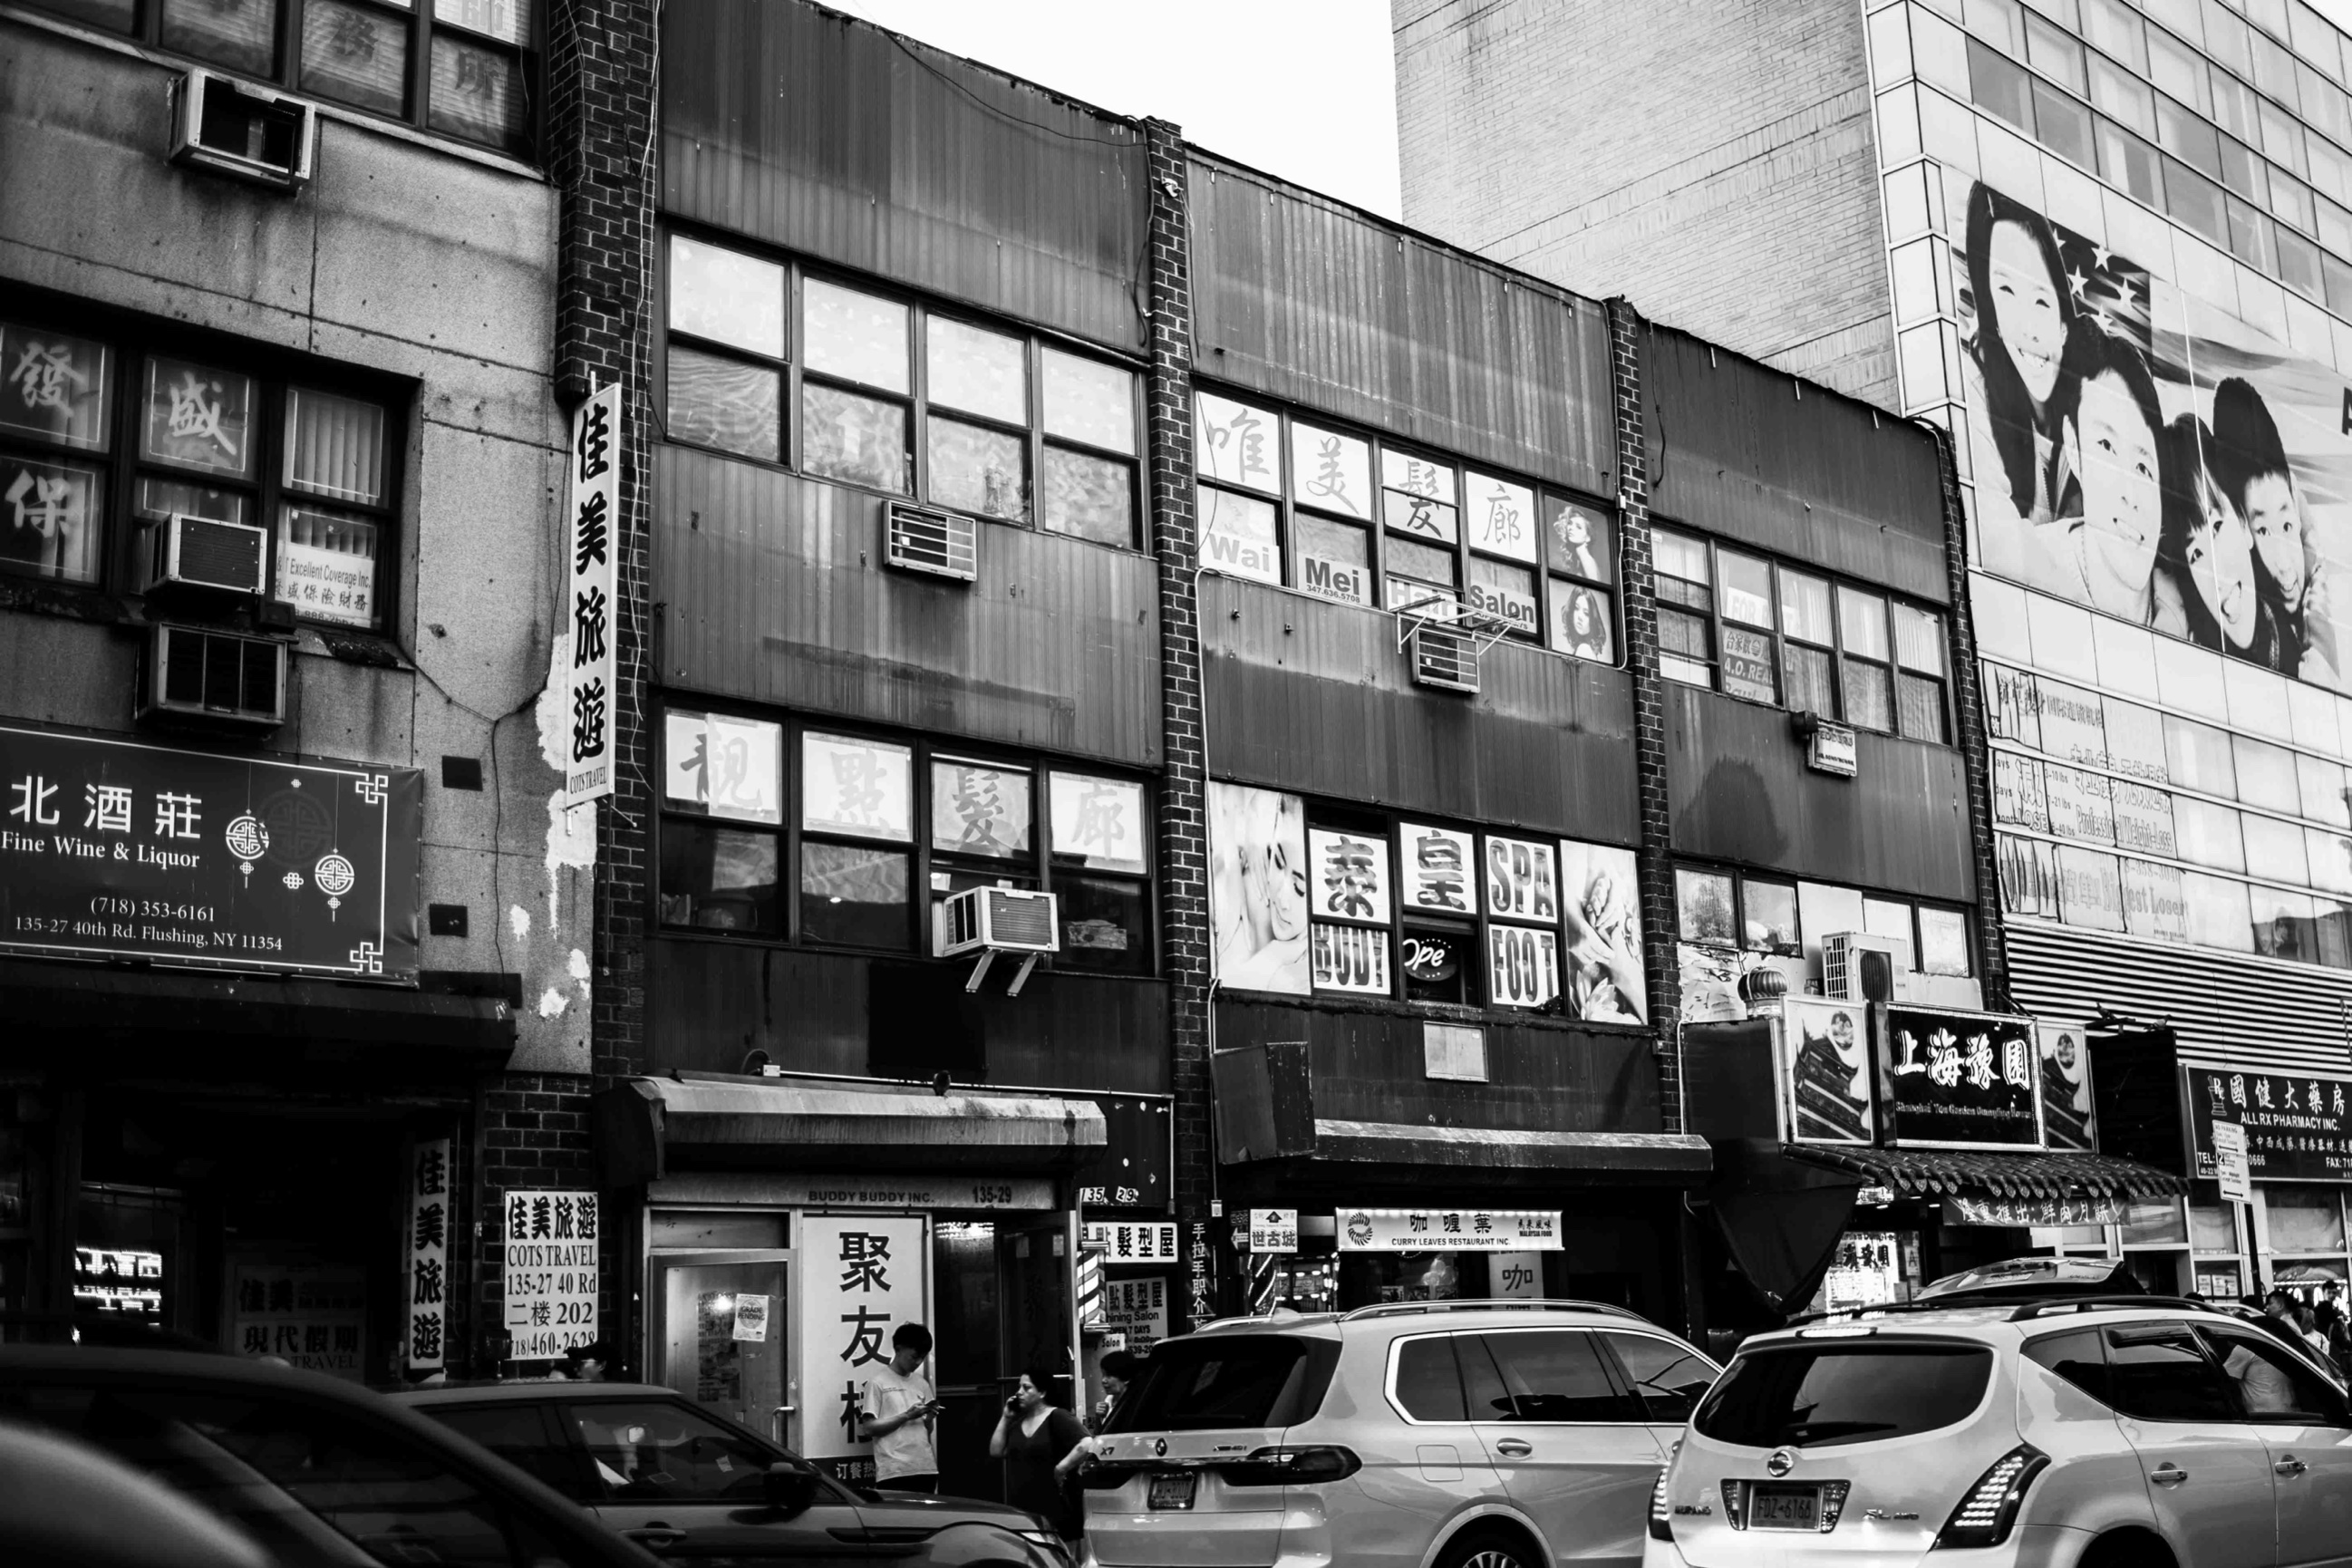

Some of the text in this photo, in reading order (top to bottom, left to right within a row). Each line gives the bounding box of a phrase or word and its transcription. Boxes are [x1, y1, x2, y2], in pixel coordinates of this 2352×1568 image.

[289, 557, 323, 581] Excellent
[324, 565, 357, 589] Coverage
[358, 569, 372, 589] Inc.
[573, 402, 609, 763] 佳美旅遊
[1208, 533, 1270, 573] Wai
[1305, 557, 1360, 595] Mei
[1470, 585, 1535, 624] Salon
[1306, 585, 1360, 604] 347.636.5708
[9, 775, 202, 839] 北酒莊
[2018, 808, 2048, 832] LOSE
[1, 830, 200, 870] Fine Wine & Liquor
[1489, 839, 1555, 918] SPA
[91, 896, 215, 922] (718) 353-6161
[15, 916, 283, 951] 135-27 40th Rd. Flushing, NY 11354
[1491, 929, 1554, 1002] FOOT
[1894, 1027, 2030, 1089] 上海豫園
[2241, 1111, 2341, 1131] ALL RX PHARMACY INC.
[2197, 1152, 2215, 1165] TEL:
[2326, 1157, 2342, 1168] FAX:
[808, 1190, 935, 1204] BUDDY BUDDY INC.
[972, 1186, 1012, 1204] 135-29
[508, 1195, 596, 1240] 佳美旅遊
[1391, 1237, 1512, 1246] CURRY LEAVES RESTAURANT INC.
[414, 1150, 445, 1360] 佳美旅遊
[508, 1244, 597, 1268] COTS TRAVEL
[508, 1273, 597, 1295] 135-27 40 Rd
[509, 1301, 594, 1327] 二楼 202
[738, 1312, 766, 1321] PENDING
[740, 1305, 763, 1313] GRADE
[1107, 1311, 1159, 1323] hining Salon
